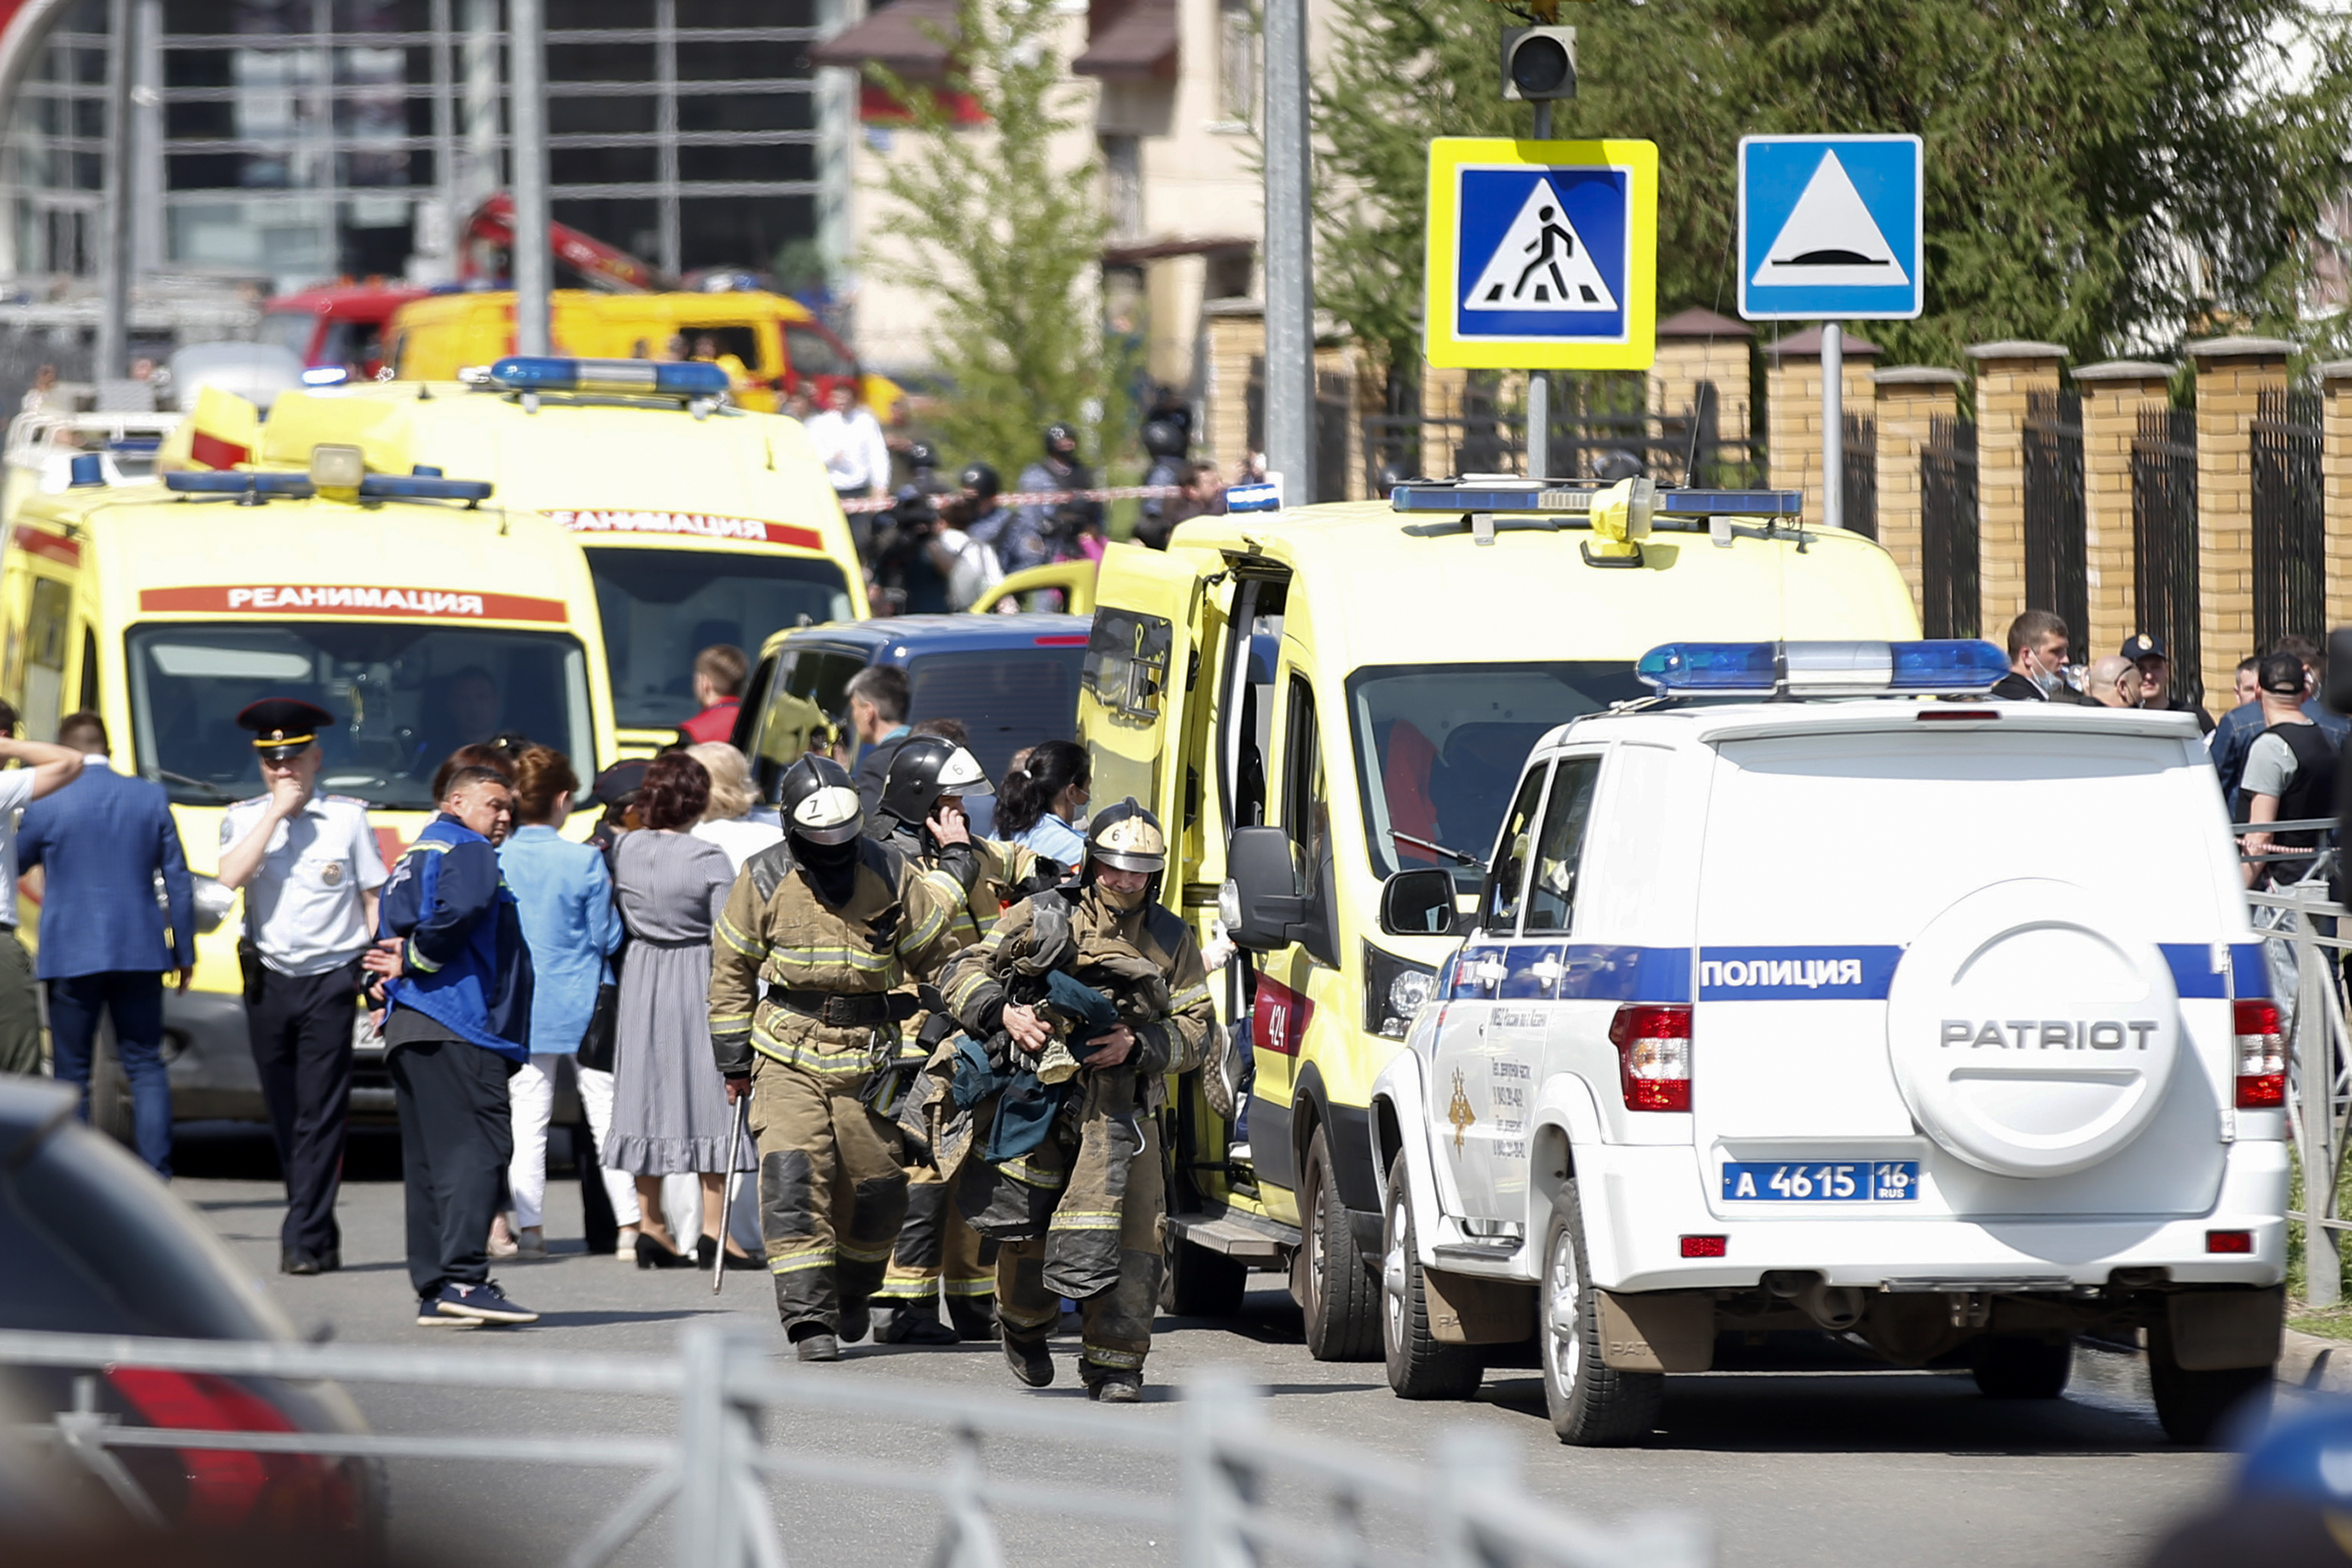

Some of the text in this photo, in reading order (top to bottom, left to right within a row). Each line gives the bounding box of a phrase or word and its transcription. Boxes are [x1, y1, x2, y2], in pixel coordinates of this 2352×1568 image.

[545, 511, 767, 540] ЕАНИМАЦИЯ
[228, 587, 483, 614] РЕАНИМАЦИЯ
[952, 764, 964, 775] 6
[1112, 828, 1120, 842] 6
[1701, 959, 1862, 989] ПОЛИЦИЯ
[1269, 1005, 1286, 1047] 424
[1940, 1020, 2159, 1050] PATRIOT
[1768, 1166, 1856, 1197] 4615
[1877, 1163, 1909, 1187] 16
[1878, 1188, 1905, 1198] RUS
